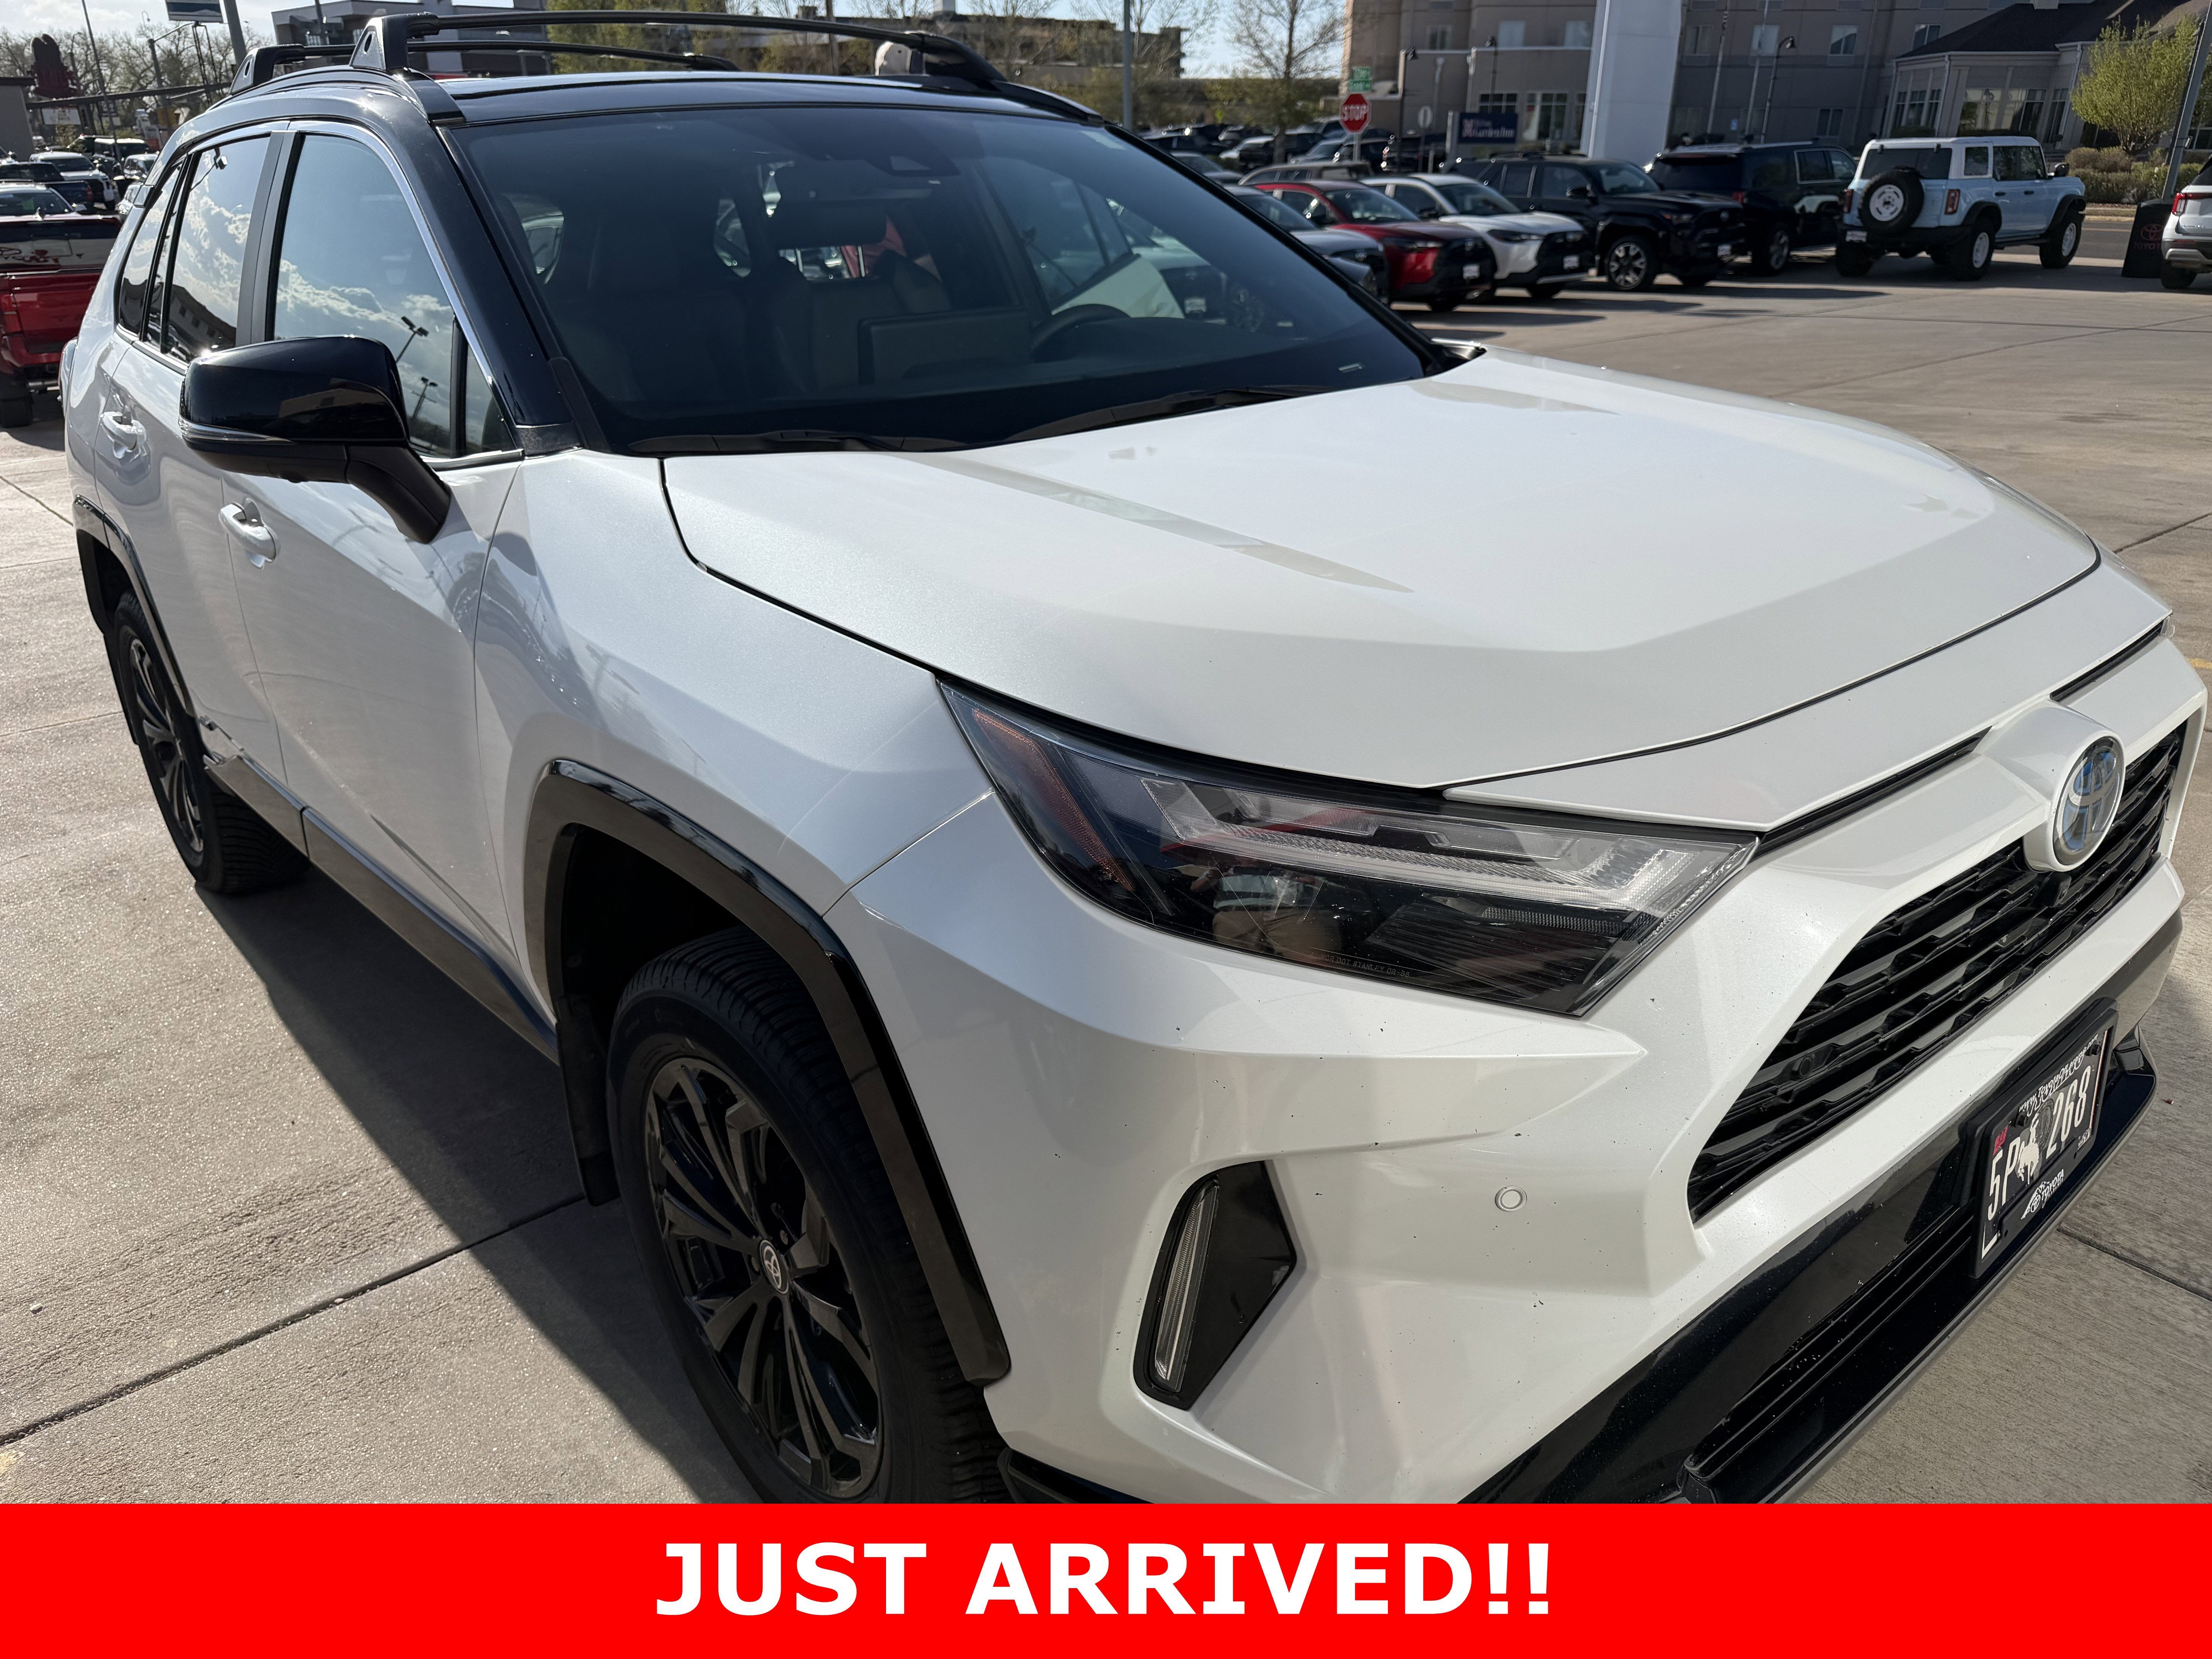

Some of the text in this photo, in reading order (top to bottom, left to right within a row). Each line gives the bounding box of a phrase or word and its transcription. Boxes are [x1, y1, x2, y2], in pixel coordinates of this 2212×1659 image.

[1343, 105, 1368, 121] STOP
[2046, 1065, 2091, 1159] 268
[2041, 1169, 2064, 1201] TOYOTA
